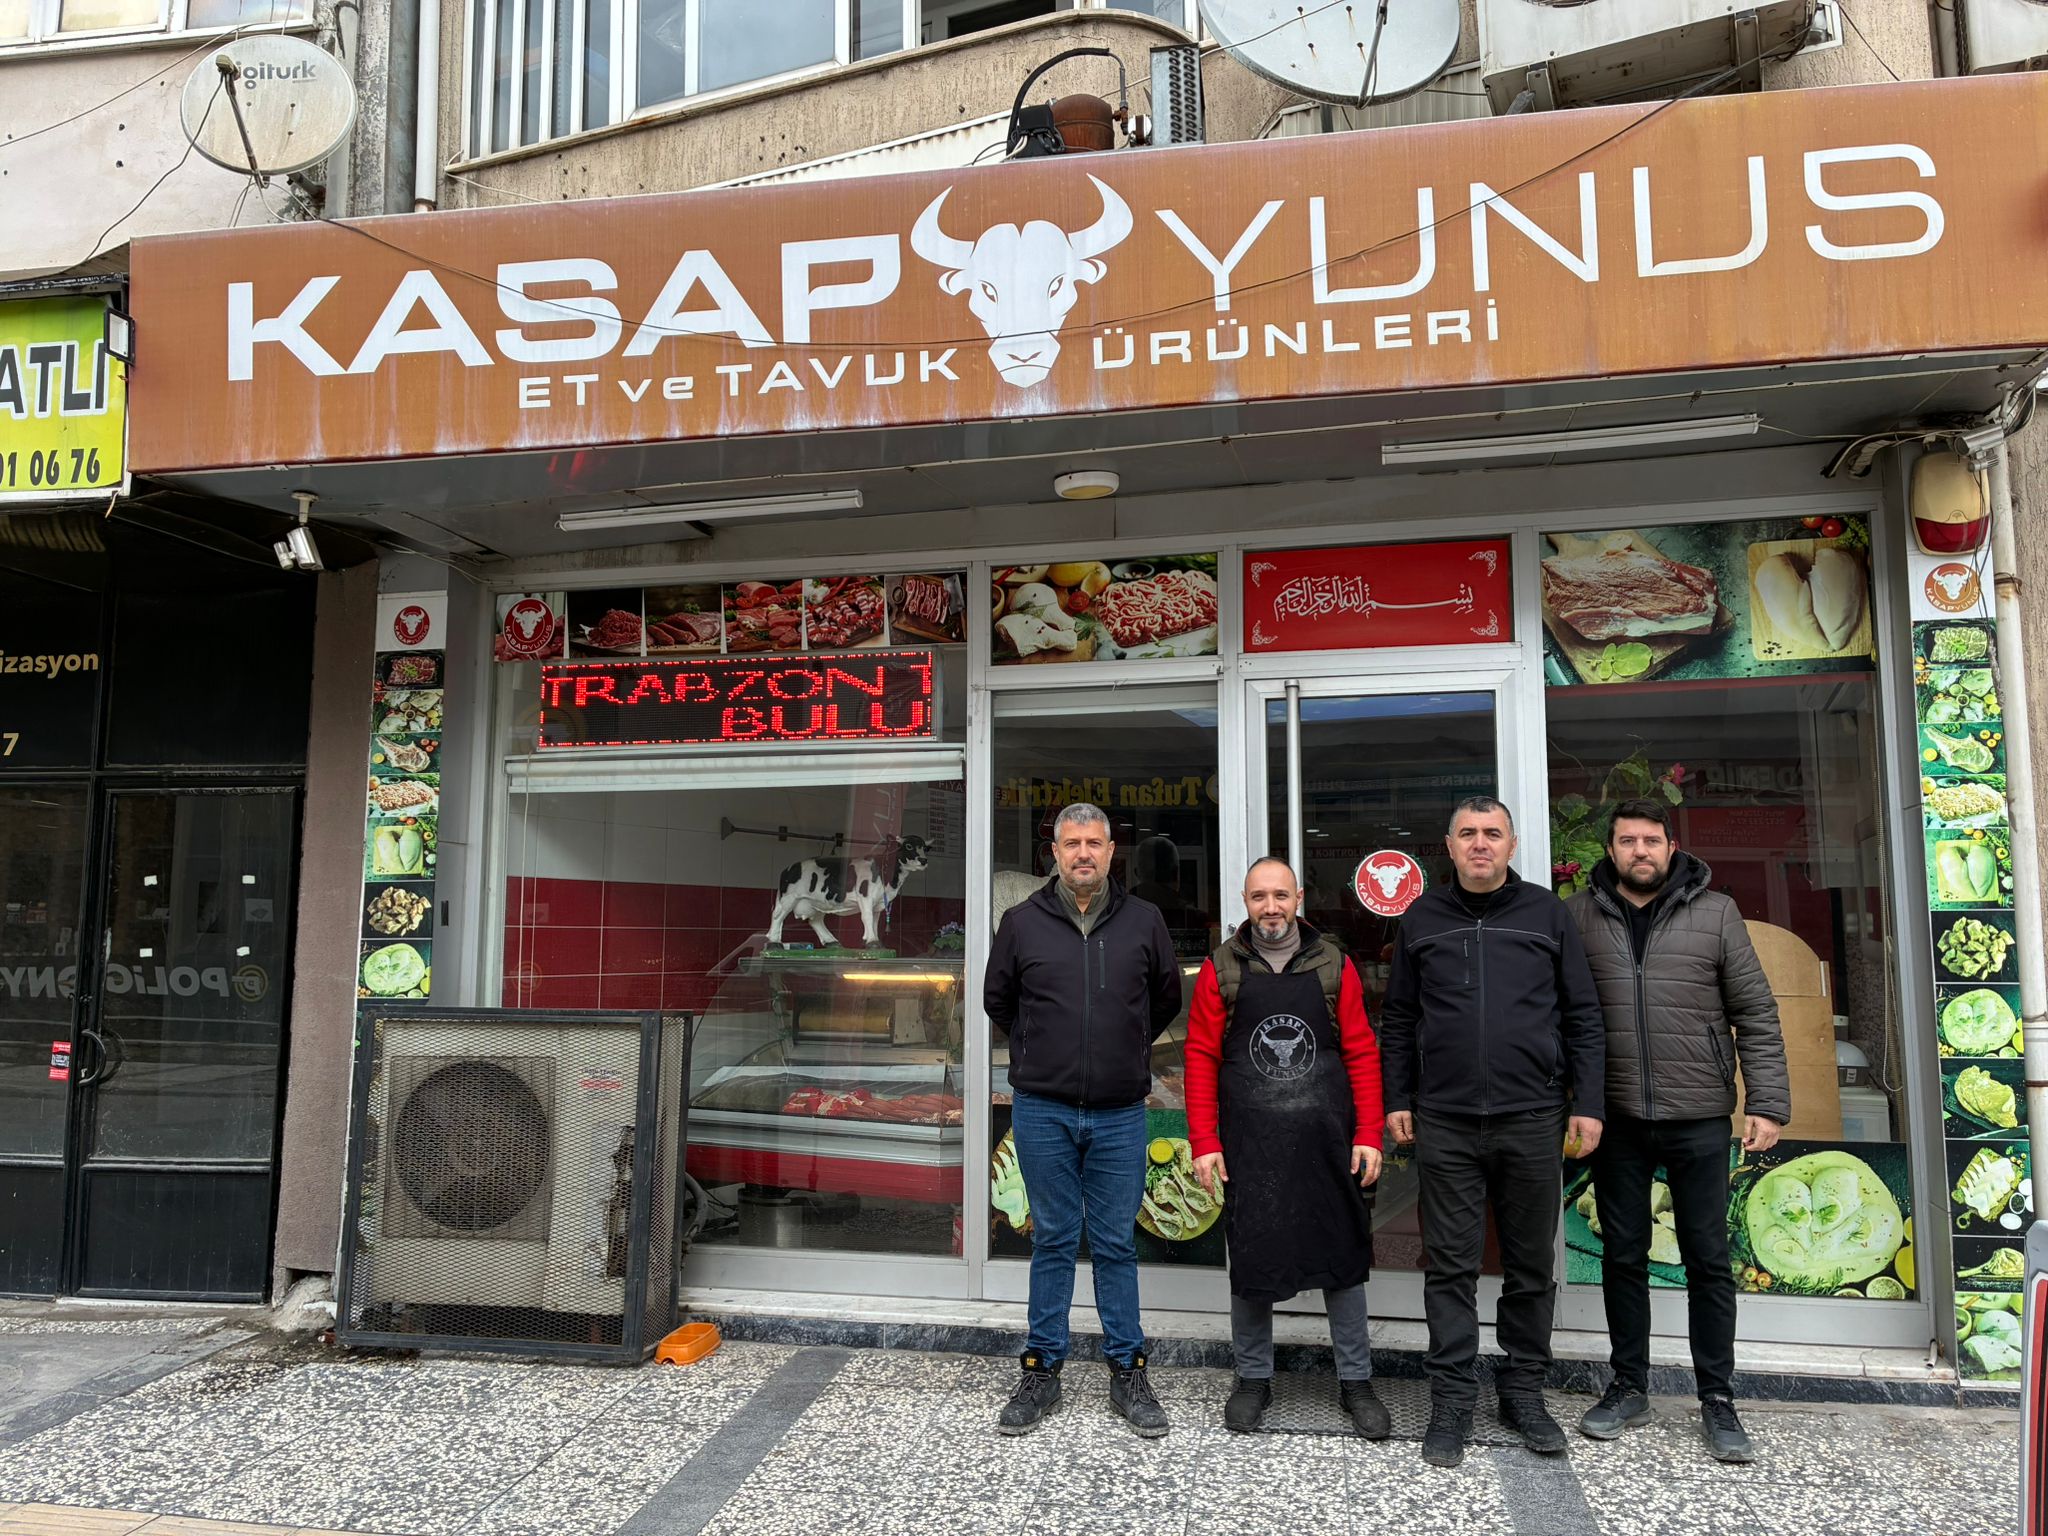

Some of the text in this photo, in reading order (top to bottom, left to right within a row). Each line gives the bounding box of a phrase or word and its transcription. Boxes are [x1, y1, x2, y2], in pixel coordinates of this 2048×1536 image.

[227, 143, 1945, 382] KASAP YUNUS
[518, 298, 1499, 409] ET ve TAVUK ÜRÜNLERİ
[29, 449, 61, 487] 06
[70, 447, 101, 484] 76
[546, 666, 884, 708] TRABZON
[721, 700, 924, 738] BULU
[3, 732, 20, 756] 7
[1263, 1017, 1301, 1030] KASAP
[1265, 1063, 1306, 1078] YUNUS
